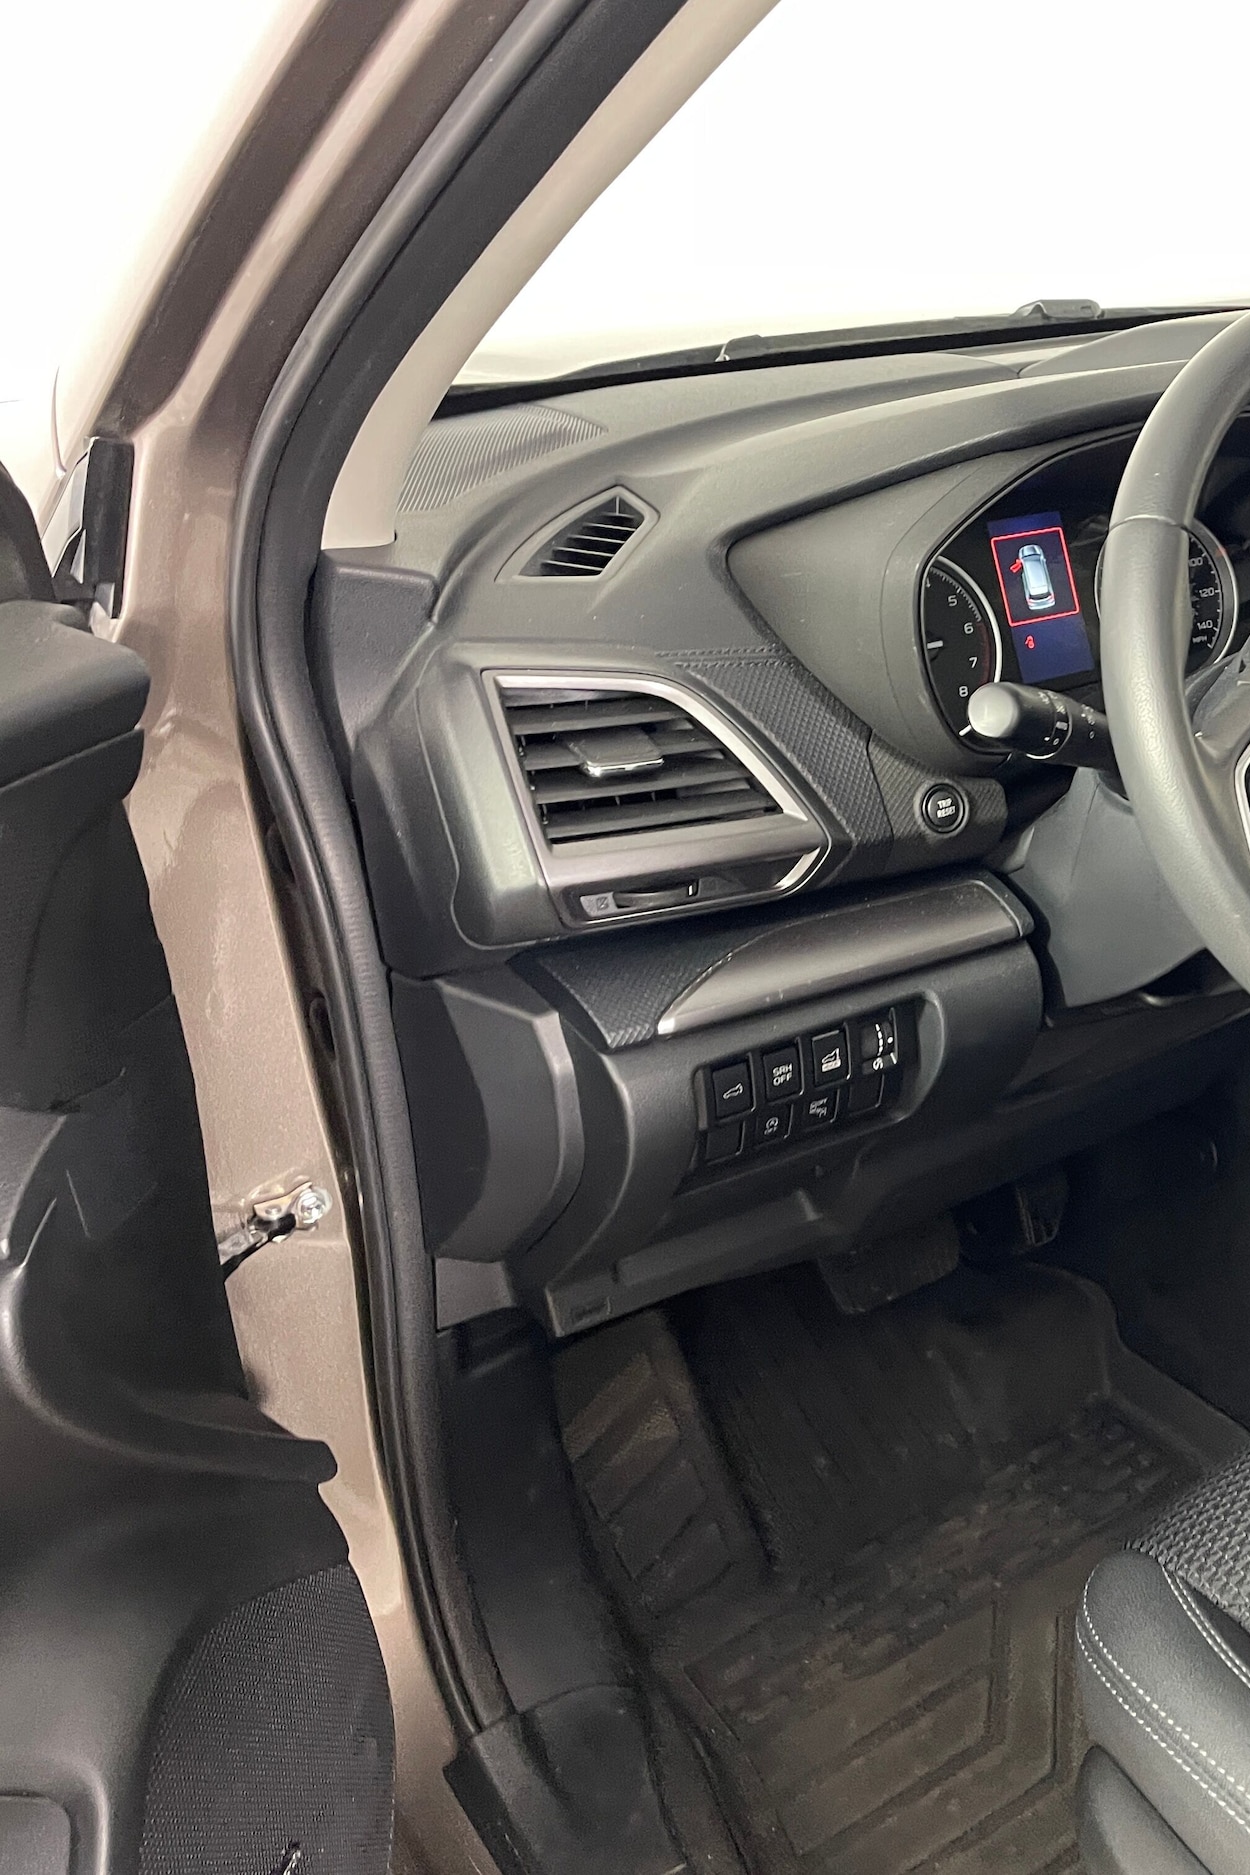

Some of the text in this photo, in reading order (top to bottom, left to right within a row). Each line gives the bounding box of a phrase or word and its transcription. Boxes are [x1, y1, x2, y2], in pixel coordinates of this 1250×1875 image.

[1199, 587, 1215, 598] 120
[947, 595, 958, 607] 5
[964, 622, 974, 634] 6
[1197, 620, 1213, 630] 140
[969, 656, 978, 669] 7
[959, 685, 969, 698] 8
[772, 1063, 793, 1078] SRH
[773, 1071, 793, 1087] OFF
